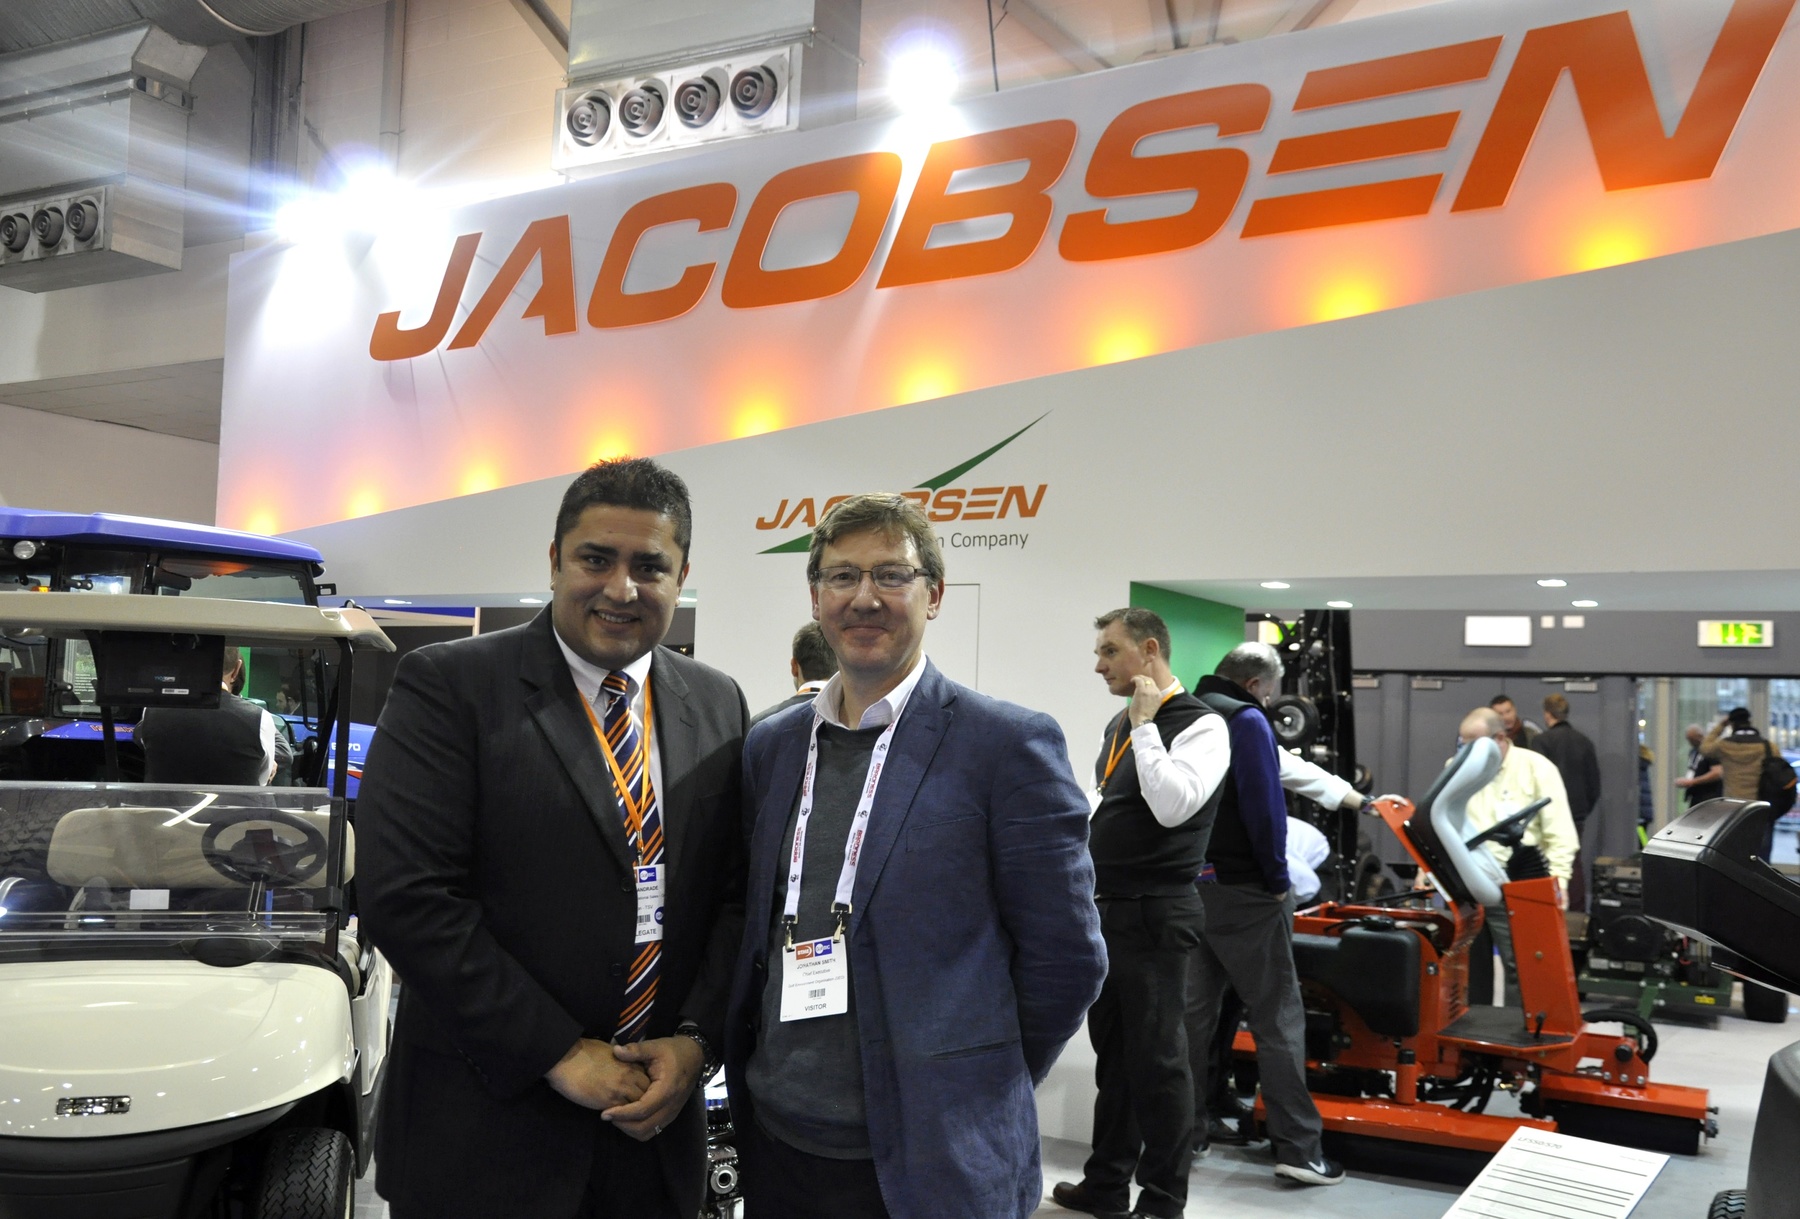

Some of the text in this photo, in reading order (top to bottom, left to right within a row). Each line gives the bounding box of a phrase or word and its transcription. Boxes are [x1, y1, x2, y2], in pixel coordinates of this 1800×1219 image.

[369, 0, 1796, 362] JACOBSEN
[755, 484, 1048, 531] JASEN
[950, 532, 1029, 550] Company
[797, 958, 836, 969] JONATHAN SMITH
[804, 1003, 827, 1012] VISITOR
